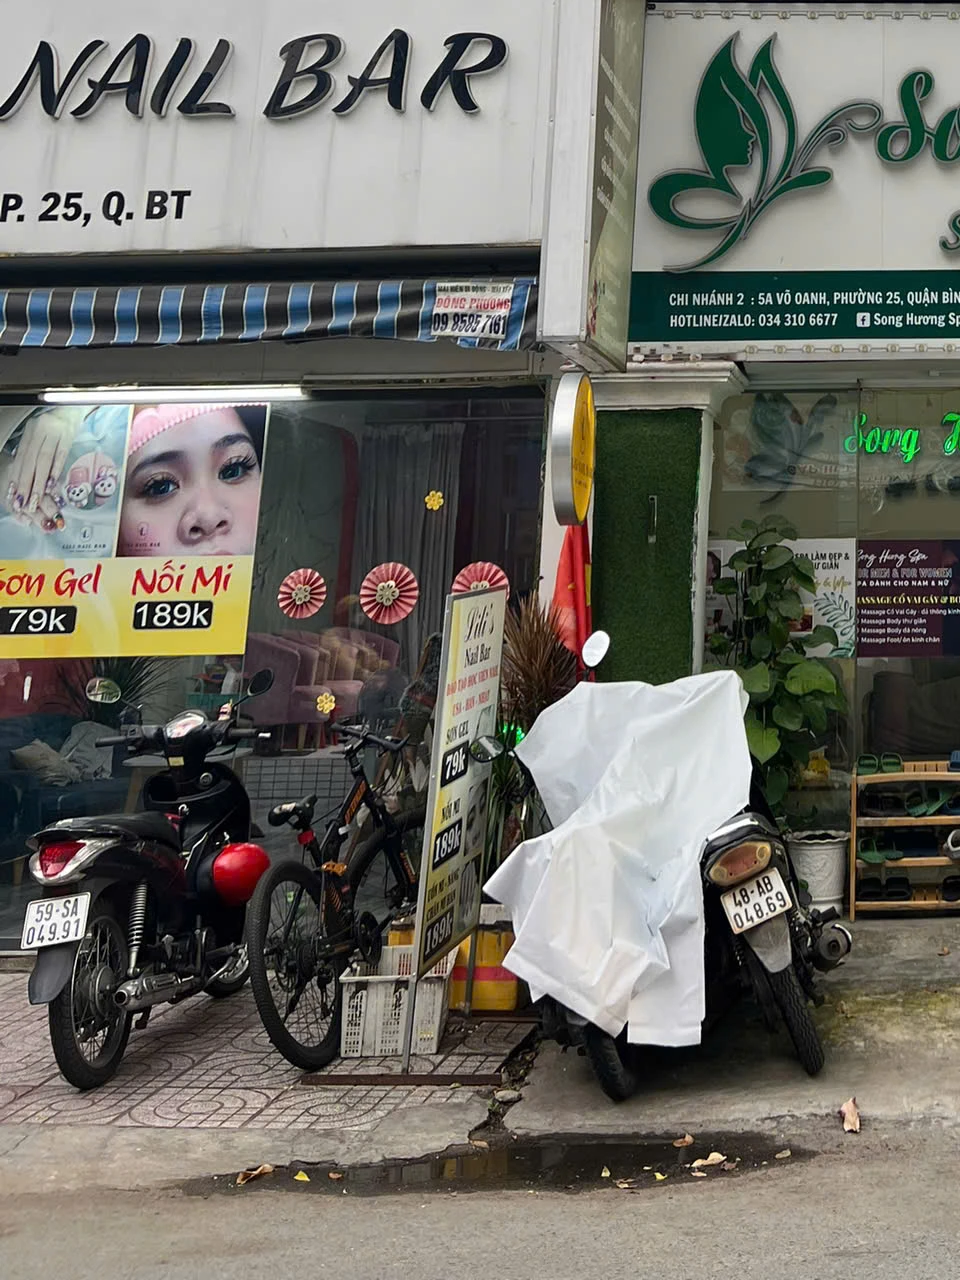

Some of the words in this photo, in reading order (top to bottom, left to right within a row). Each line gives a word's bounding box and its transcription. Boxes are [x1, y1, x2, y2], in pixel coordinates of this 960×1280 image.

[0, 33, 236, 120] NAIL
[262, 28, 510, 120] BAR
[0, 191, 24, 222] P.
[38, 192, 91, 227] 25,
[101, 190, 134, 227] Q.
[145, 189, 192, 220] BT
[669, 293, 688, 306] CHI
[692, 289, 733, 306] NHÁNH
[736, 293, 744, 305] 2
[758, 293, 773, 306] 5A
[776, 289, 792, 305] VÕ
[794, 292, 830, 307] OANH,
[833, 288, 883, 305] PHƯỜNG
[886, 291, 903, 307] 25,
[907, 287, 938, 307] QUẬN
[433, 313, 449, 331] 09
[481, 314, 507, 335] 7161
[670, 314, 755, 327] HOTLINE/ZALO:
[758, 314, 781, 327] 034
[784, 314, 805, 327] 310
[809, 313, 838, 326] 6677
[874, 313, 902, 327] Song
[906, 313, 945, 327] Hương
[844, 412, 920, 463] Song
[811, 551, 827, 561] LÀM
[829, 552, 843, 563] ĐẸP
[843, 552, 850, 561] &
[54, 563, 102, 598] Gel
[131, 560, 187, 596] Nối
[191, 563, 234, 596] Mi
[869, 577, 891, 587] DÀNH
[894, 579, 909, 587] CHO
[911, 578, 929, 587] NAM
[8, 608, 67, 633] 79k
[135, 602, 210, 628] 189k
[861, 608, 885, 616] Massage
[861, 618, 885, 626] Massage
[886, 618, 901, 626] Body
[886, 627, 902, 635] Body
[464, 645, 479, 668] Nail
[479, 643, 491, 663] Bar
[445, 747, 466, 780] 79k
[433, 822, 462, 863] 189k
[732, 875, 774, 908] 48-AB
[35, 897, 79, 923] 59-SA
[733, 890, 787, 929] 048.69
[26, 918, 81, 946] 049.91
[424, 914, 454, 956] 189k
